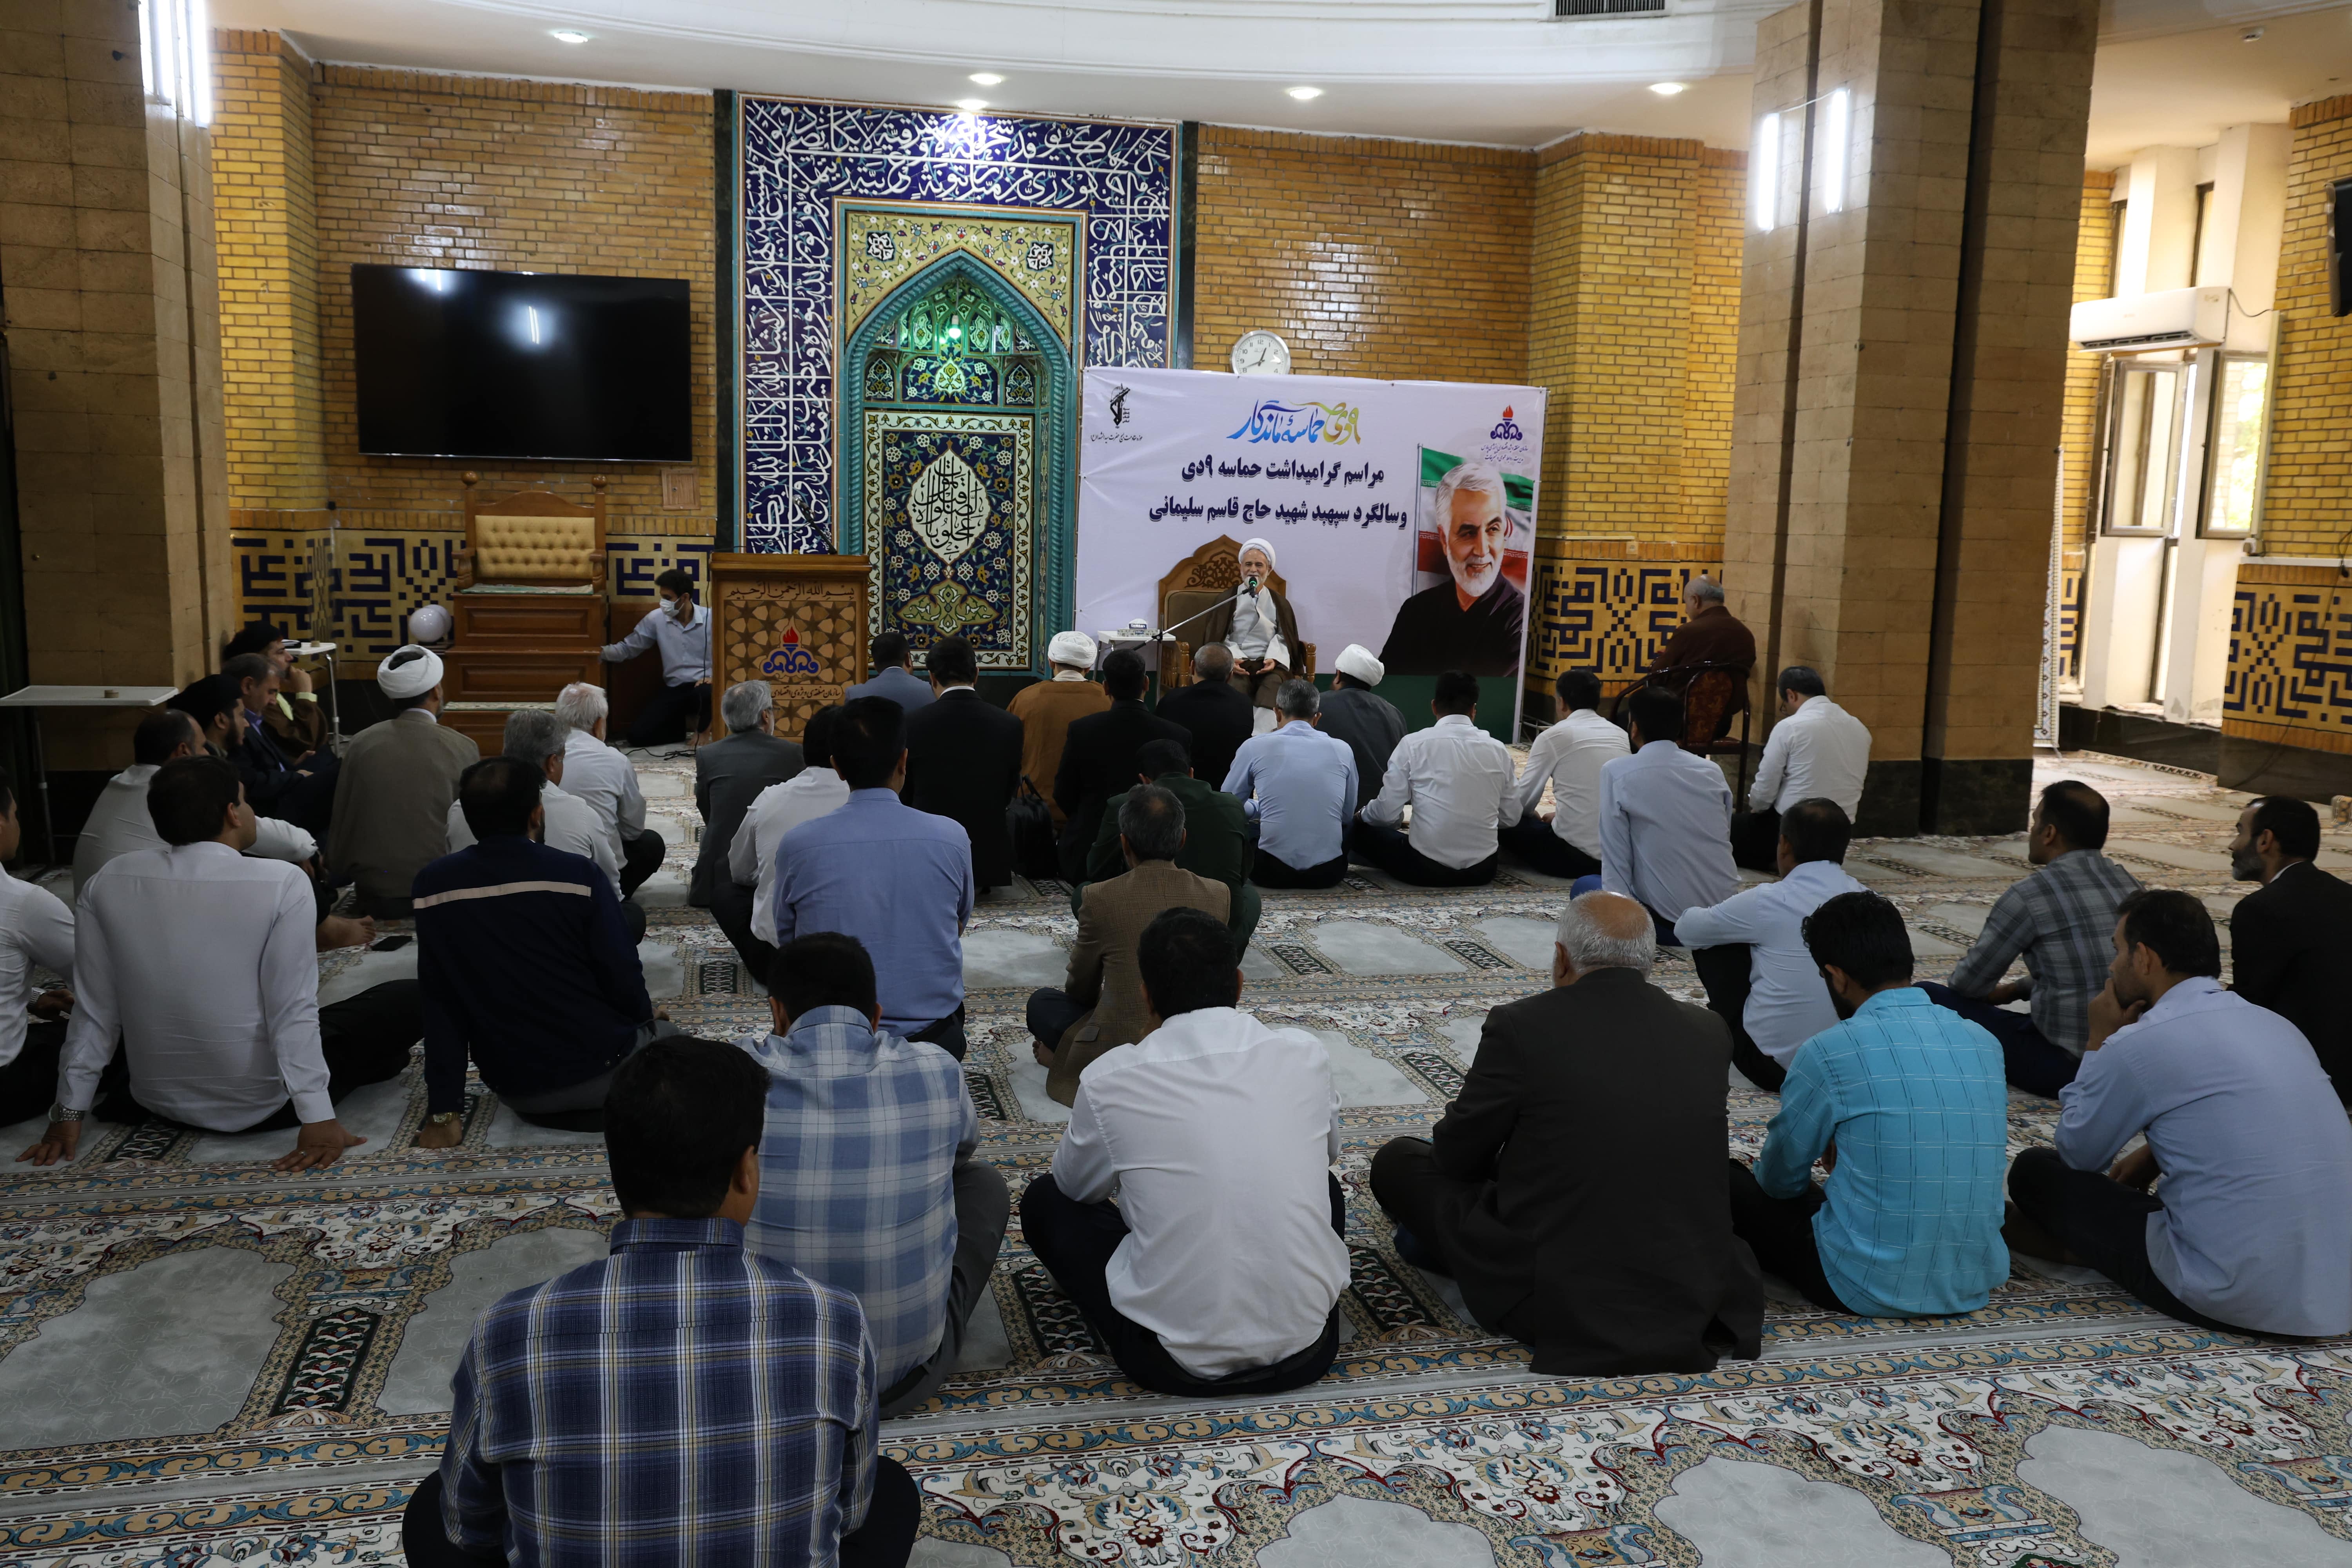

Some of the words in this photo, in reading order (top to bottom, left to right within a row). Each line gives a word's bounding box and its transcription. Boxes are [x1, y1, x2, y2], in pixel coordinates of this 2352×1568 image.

[1226, 399, 1307, 443] ماندگار
[1218, 457, 1262, 479] حماسه
[1266, 459, 1341, 487] گرامیداشت
[1344, 462, 1384, 488] مراسم
[1149, 494, 1204, 523] سلیمانی
[1207, 495, 1239, 523] قاسم
[1242, 499, 1271, 524] حاج
[1275, 500, 1308, 524] شهید
[1312, 503, 1350, 526] سپهبد
[823, 688, 840, 698] سازمان
